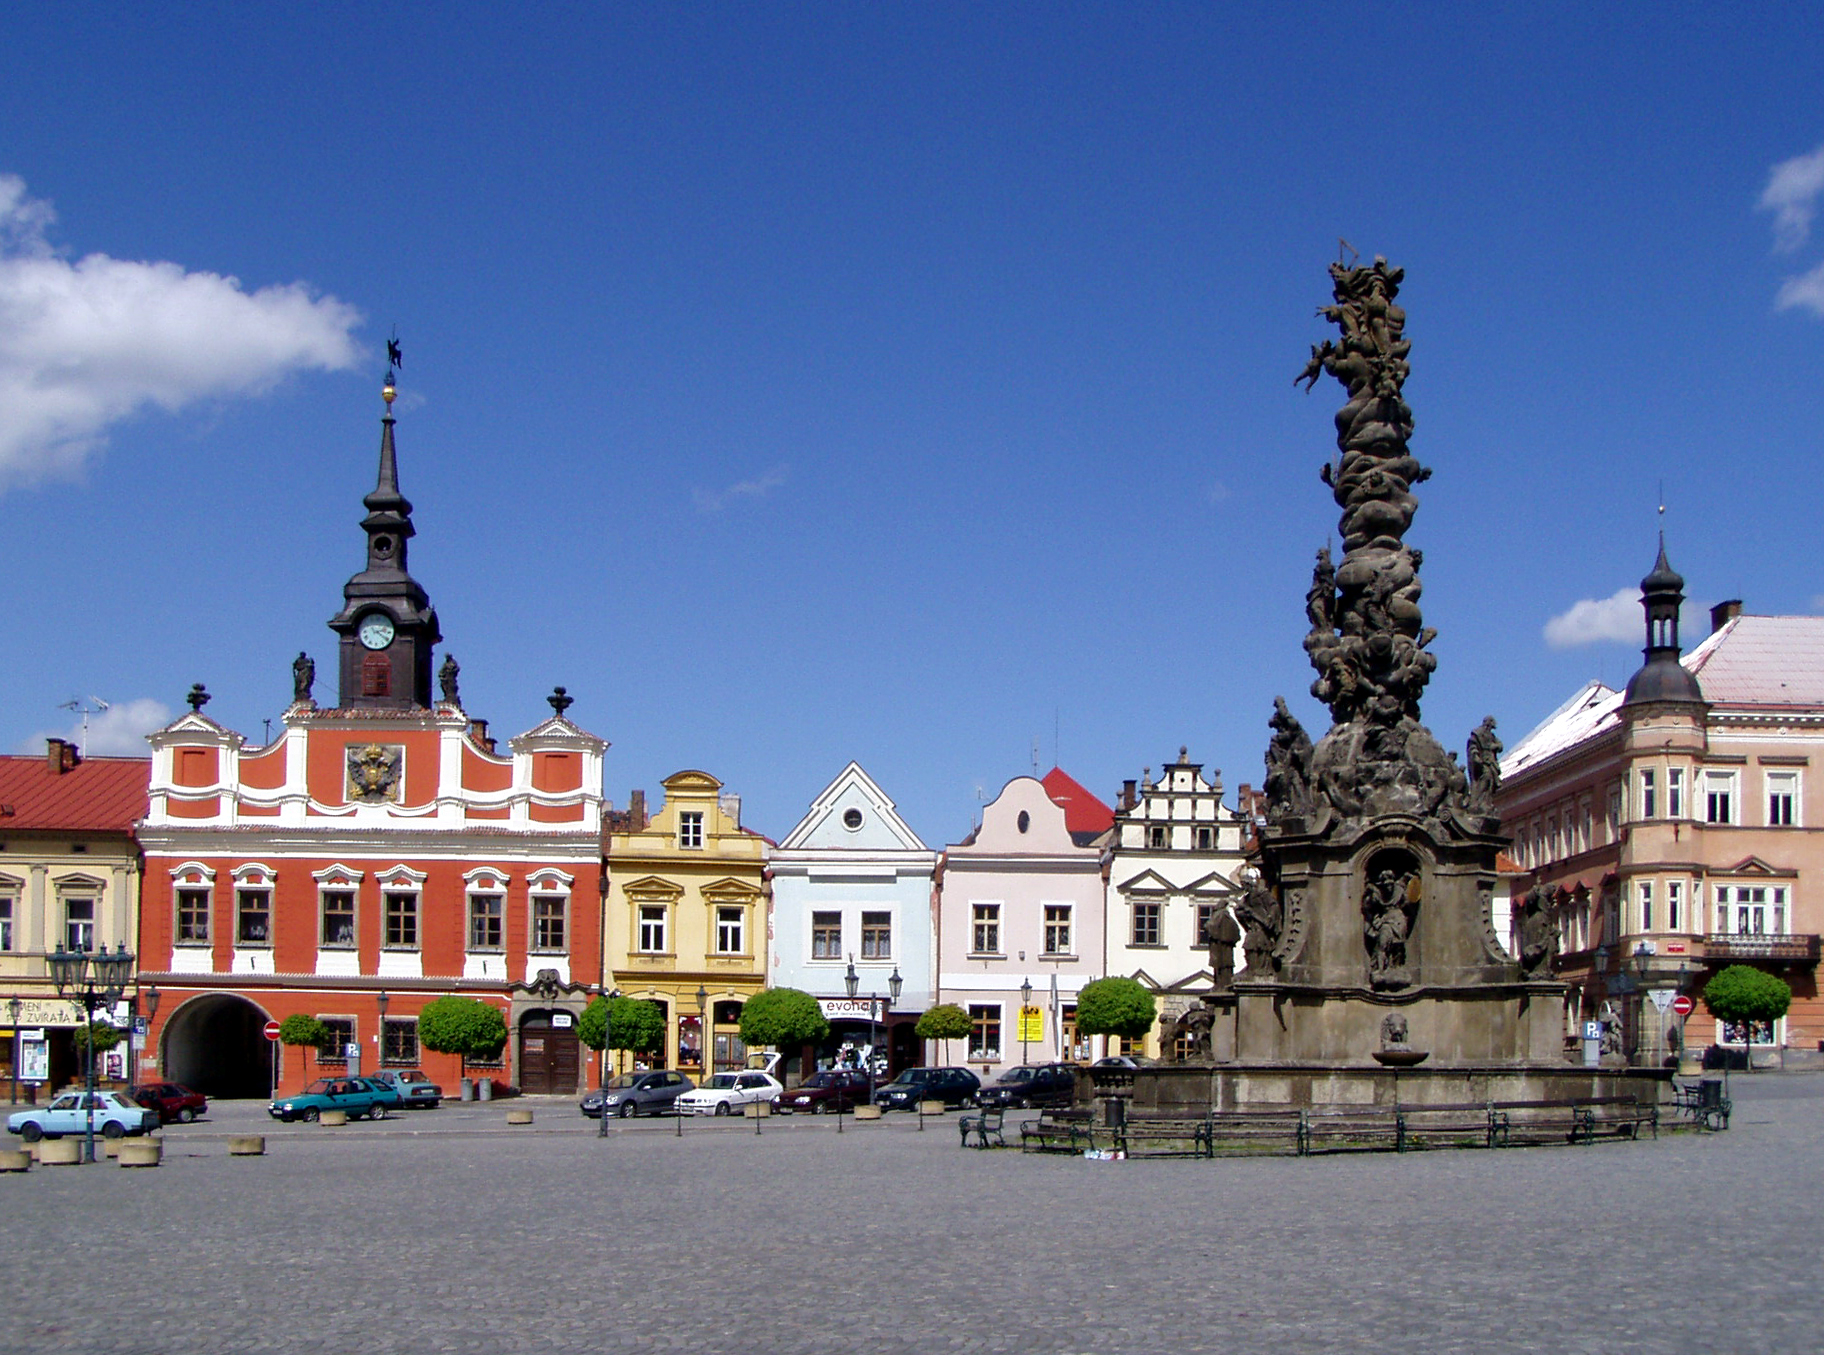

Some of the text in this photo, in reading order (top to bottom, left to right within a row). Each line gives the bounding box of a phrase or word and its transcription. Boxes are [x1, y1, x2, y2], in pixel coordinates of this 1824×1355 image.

[827, 1002, 871, 1011] evona
[1588, 1022, 1596, 1035] P
[349, 1043, 356, 1053] P
